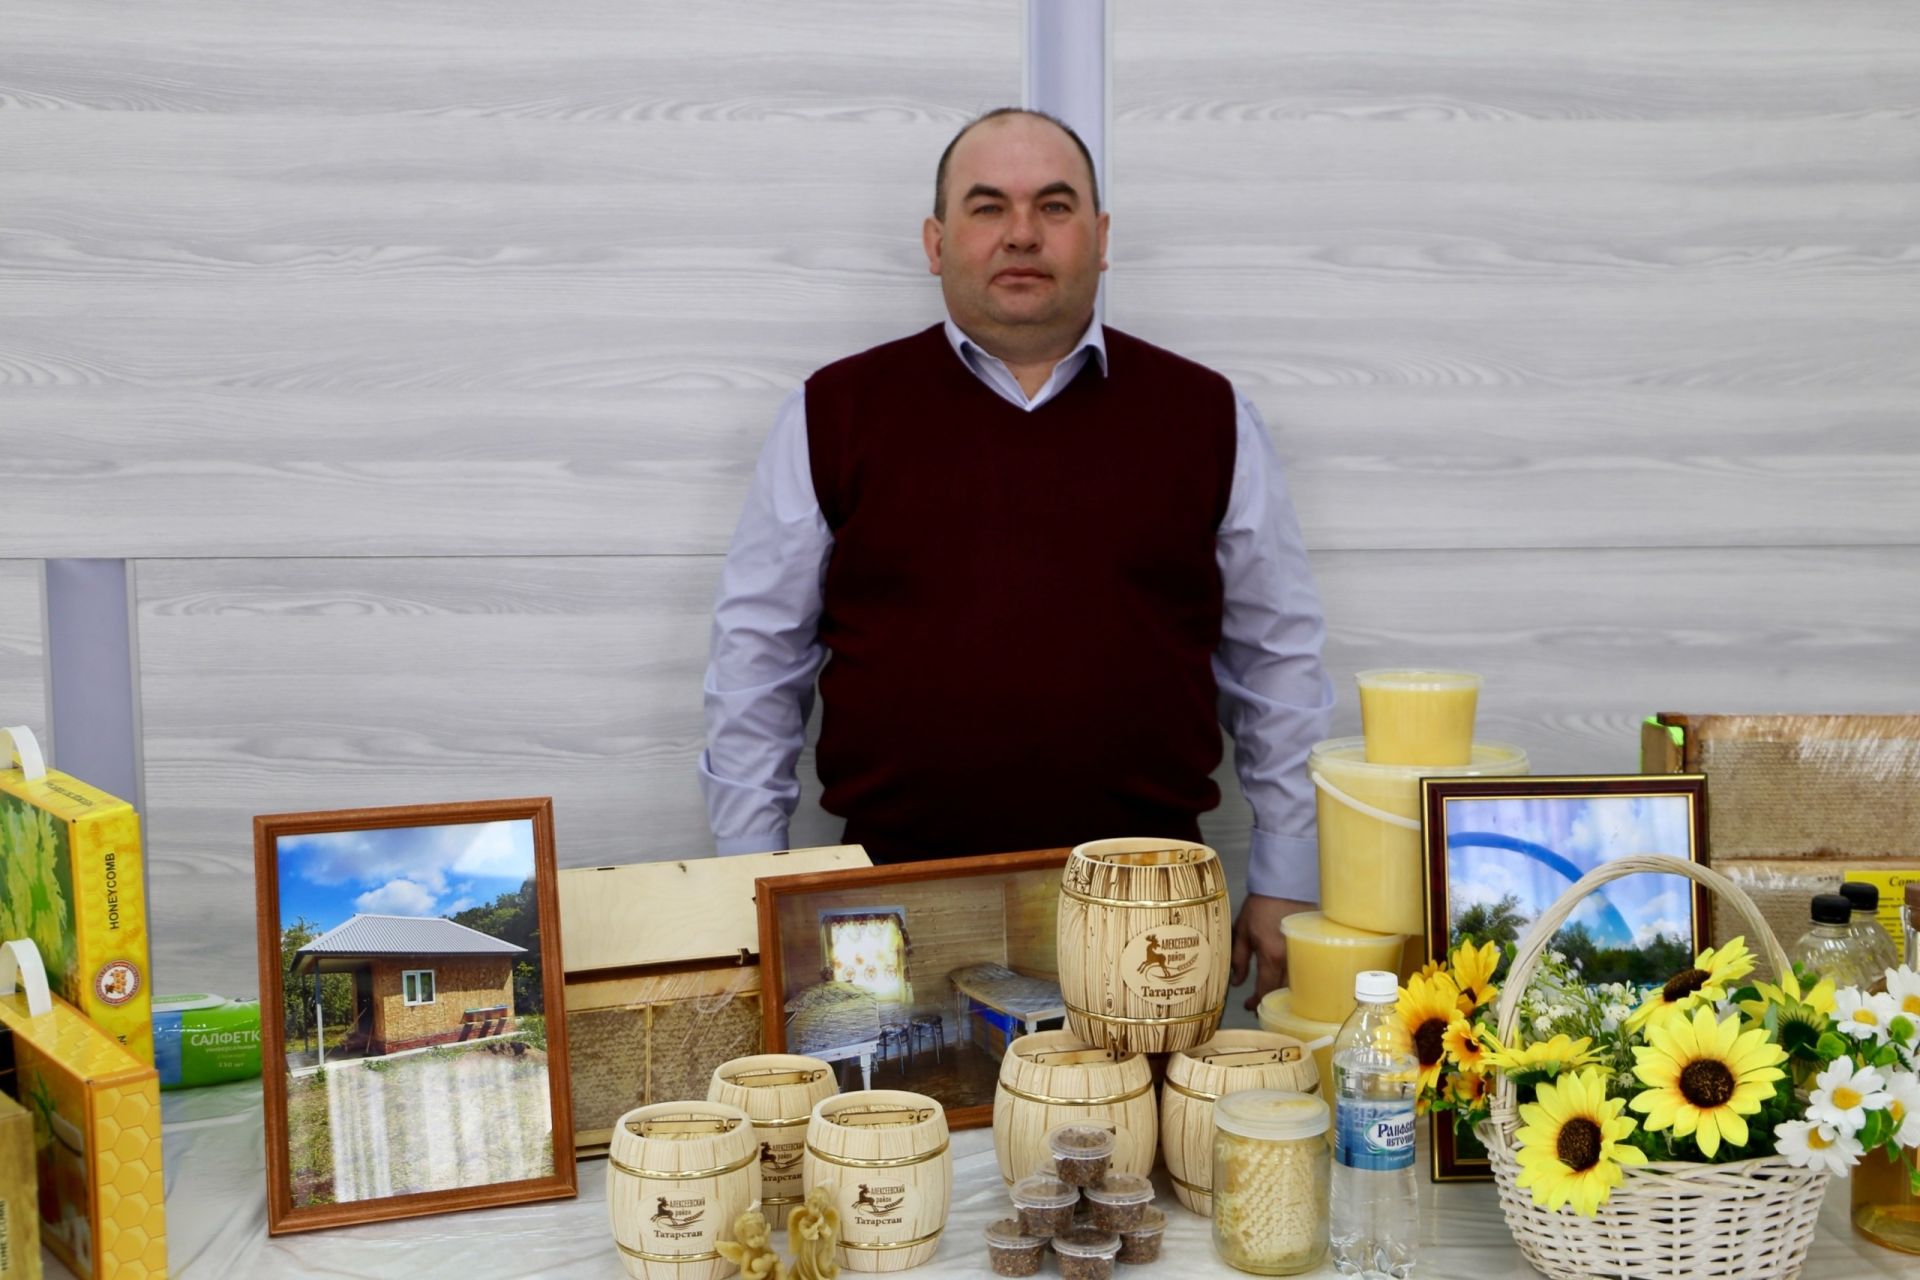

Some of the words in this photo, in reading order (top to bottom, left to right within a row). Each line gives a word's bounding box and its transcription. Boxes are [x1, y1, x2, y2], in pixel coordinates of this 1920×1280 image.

[105, 852, 119, 930] HONEYCOMB
[1161, 933, 1199, 950] АЛЕКСЕЕВСКИЙ
[1168, 951, 1185, 965] район
[1141, 985, 1196, 1000] Татарстан
[191, 1030, 261, 1046] САЛФЕТК
[855, 1216, 903, 1227] Татарстан
[653, 1229, 703, 1240] Татарстан
